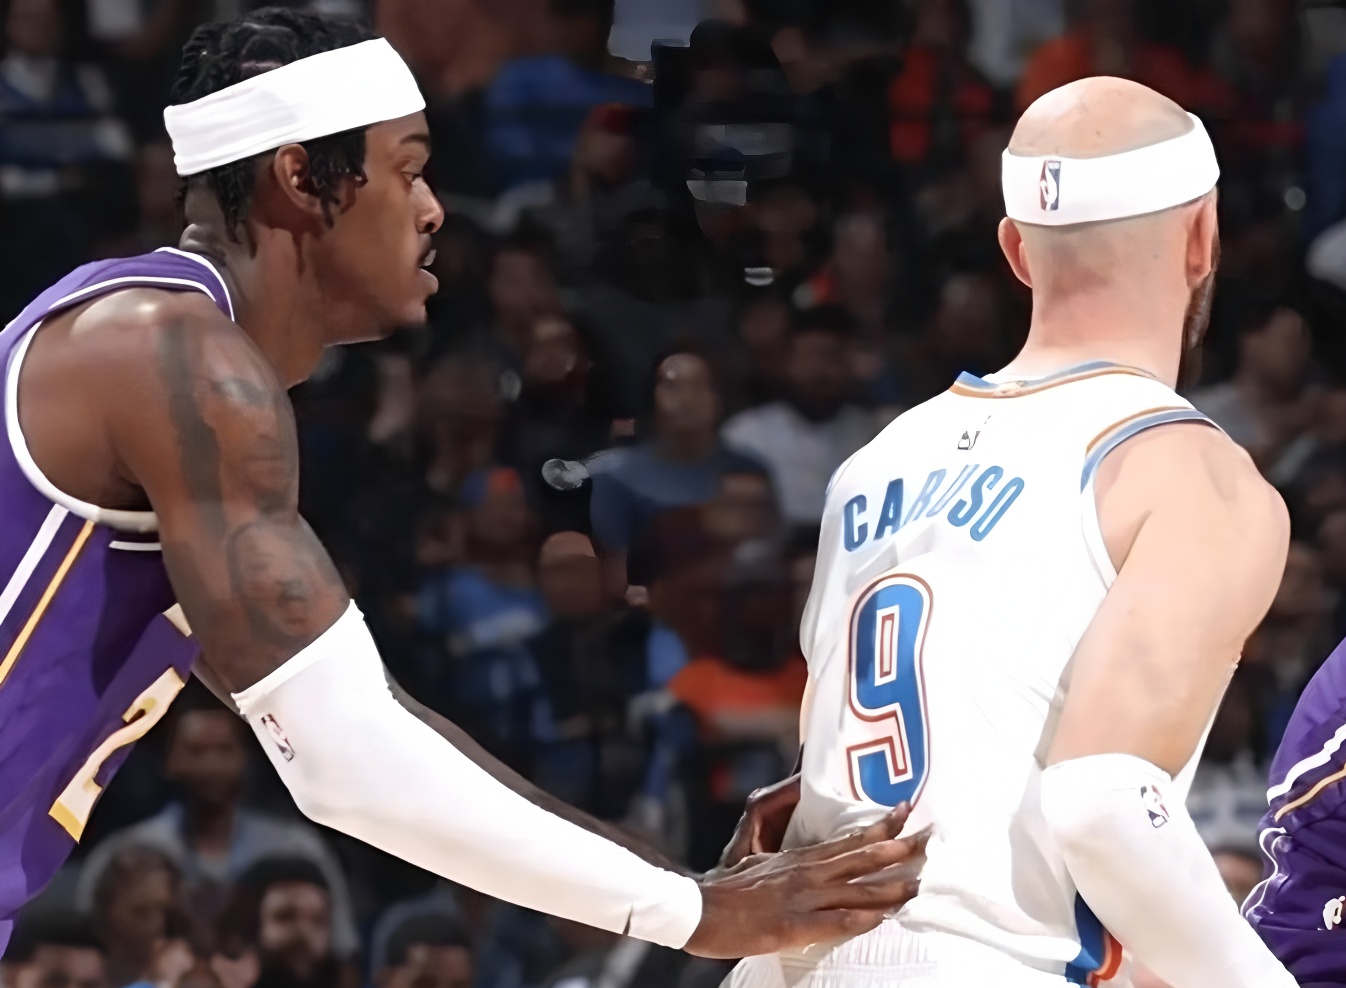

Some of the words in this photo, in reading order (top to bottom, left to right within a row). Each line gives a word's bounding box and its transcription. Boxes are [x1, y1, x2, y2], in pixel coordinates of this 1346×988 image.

[843, 463, 1025, 543] CARUSO
[48, 666, 185, 844] 2
[846, 573, 934, 812] 9
